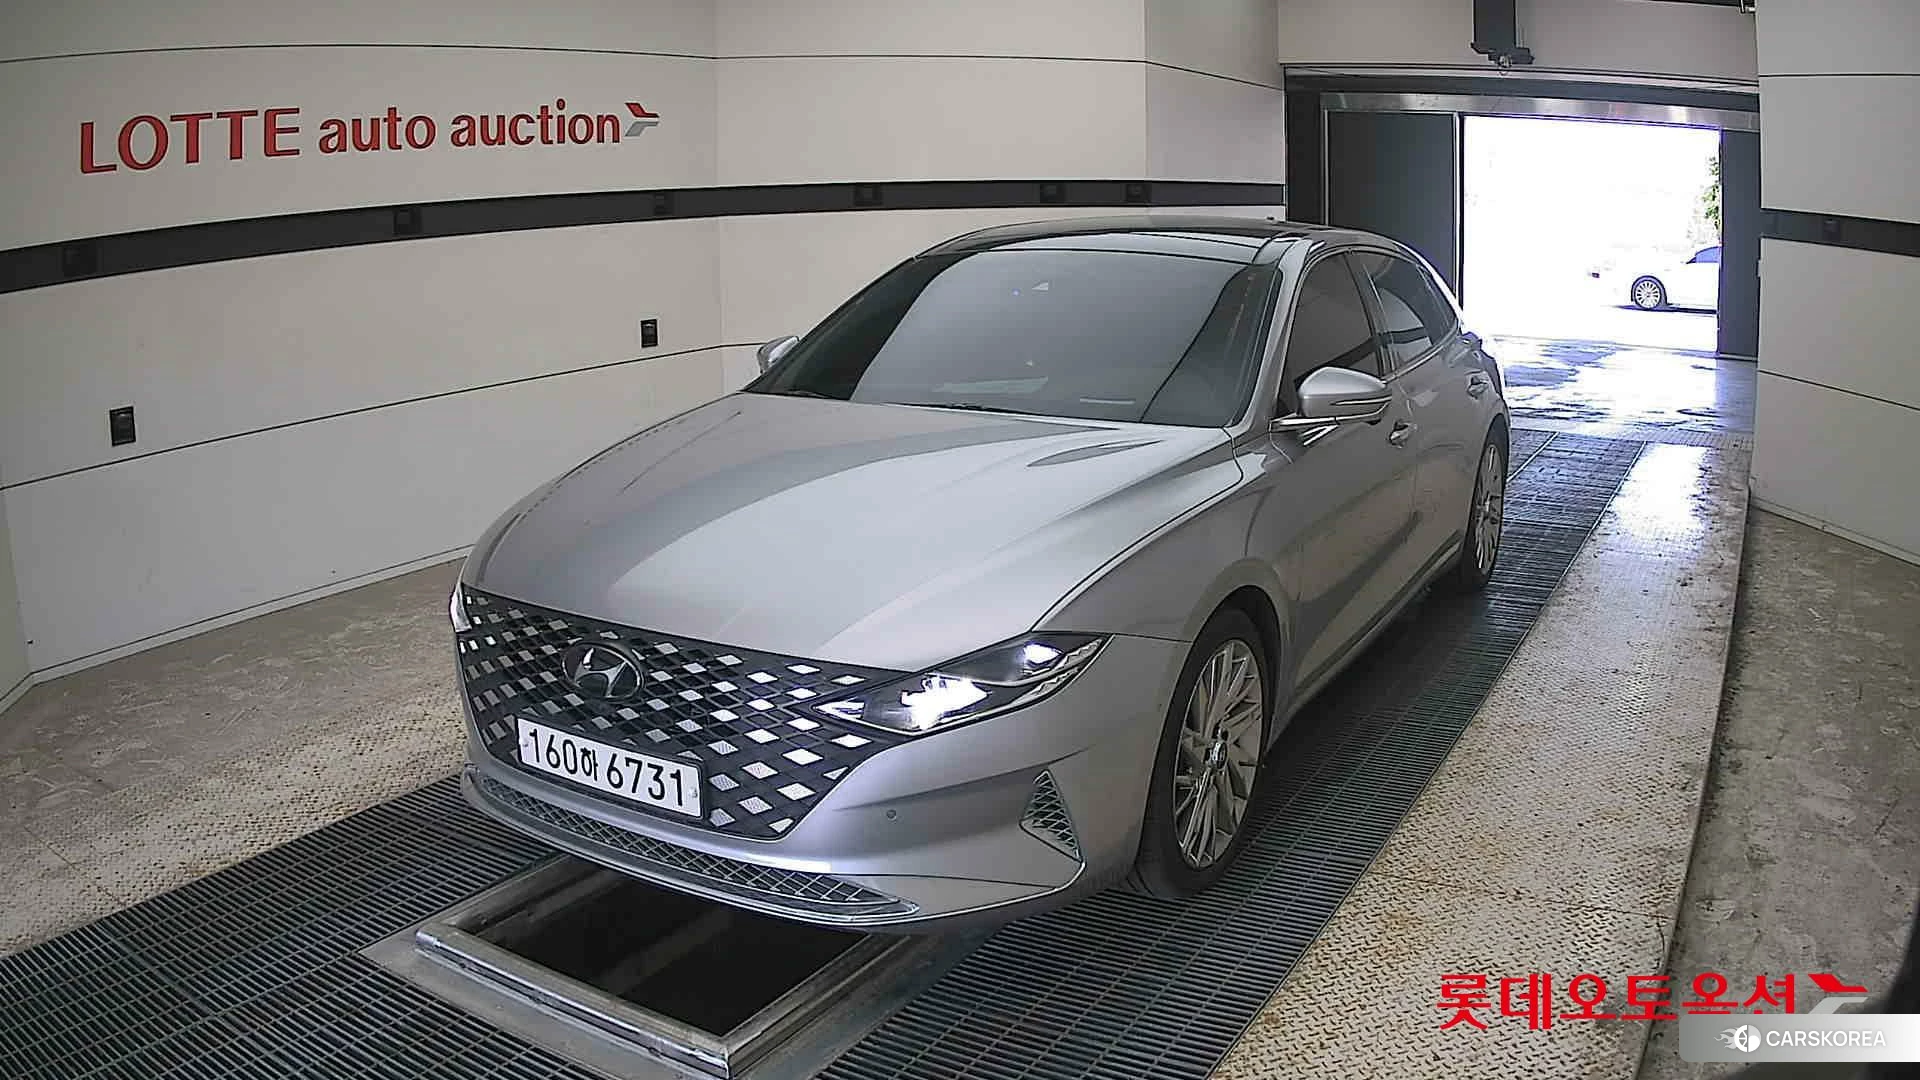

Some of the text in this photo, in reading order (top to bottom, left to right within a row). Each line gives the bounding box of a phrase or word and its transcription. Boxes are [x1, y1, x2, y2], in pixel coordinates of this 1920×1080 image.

[80, 98, 622, 174] LOTTE auto auction
[529, 728, 684, 807] 160하 6731
